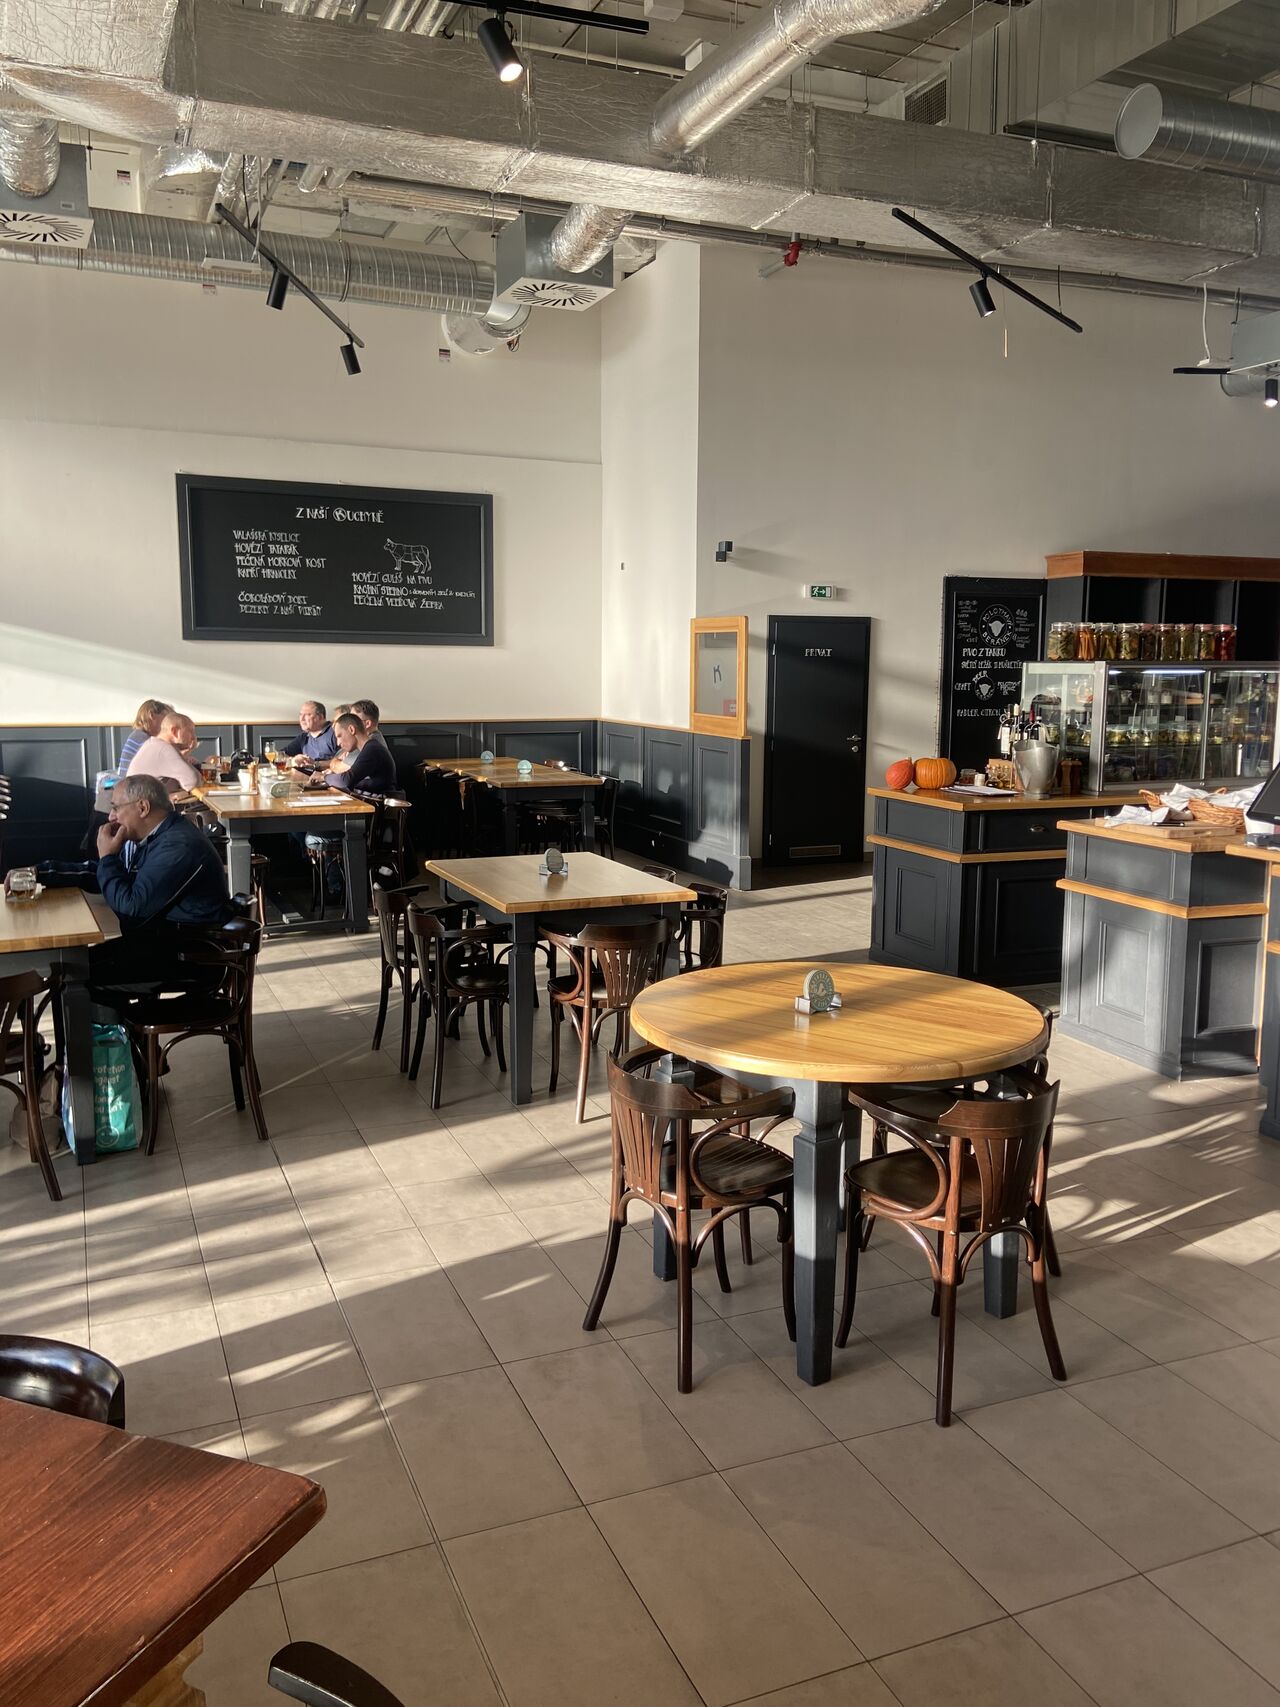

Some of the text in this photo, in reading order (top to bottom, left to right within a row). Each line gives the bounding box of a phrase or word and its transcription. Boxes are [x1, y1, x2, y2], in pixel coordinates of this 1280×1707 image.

[296, 507, 304, 518] Z
[306, 506, 329, 519] NAŠÍ
[306, 558, 327, 568] KOST
